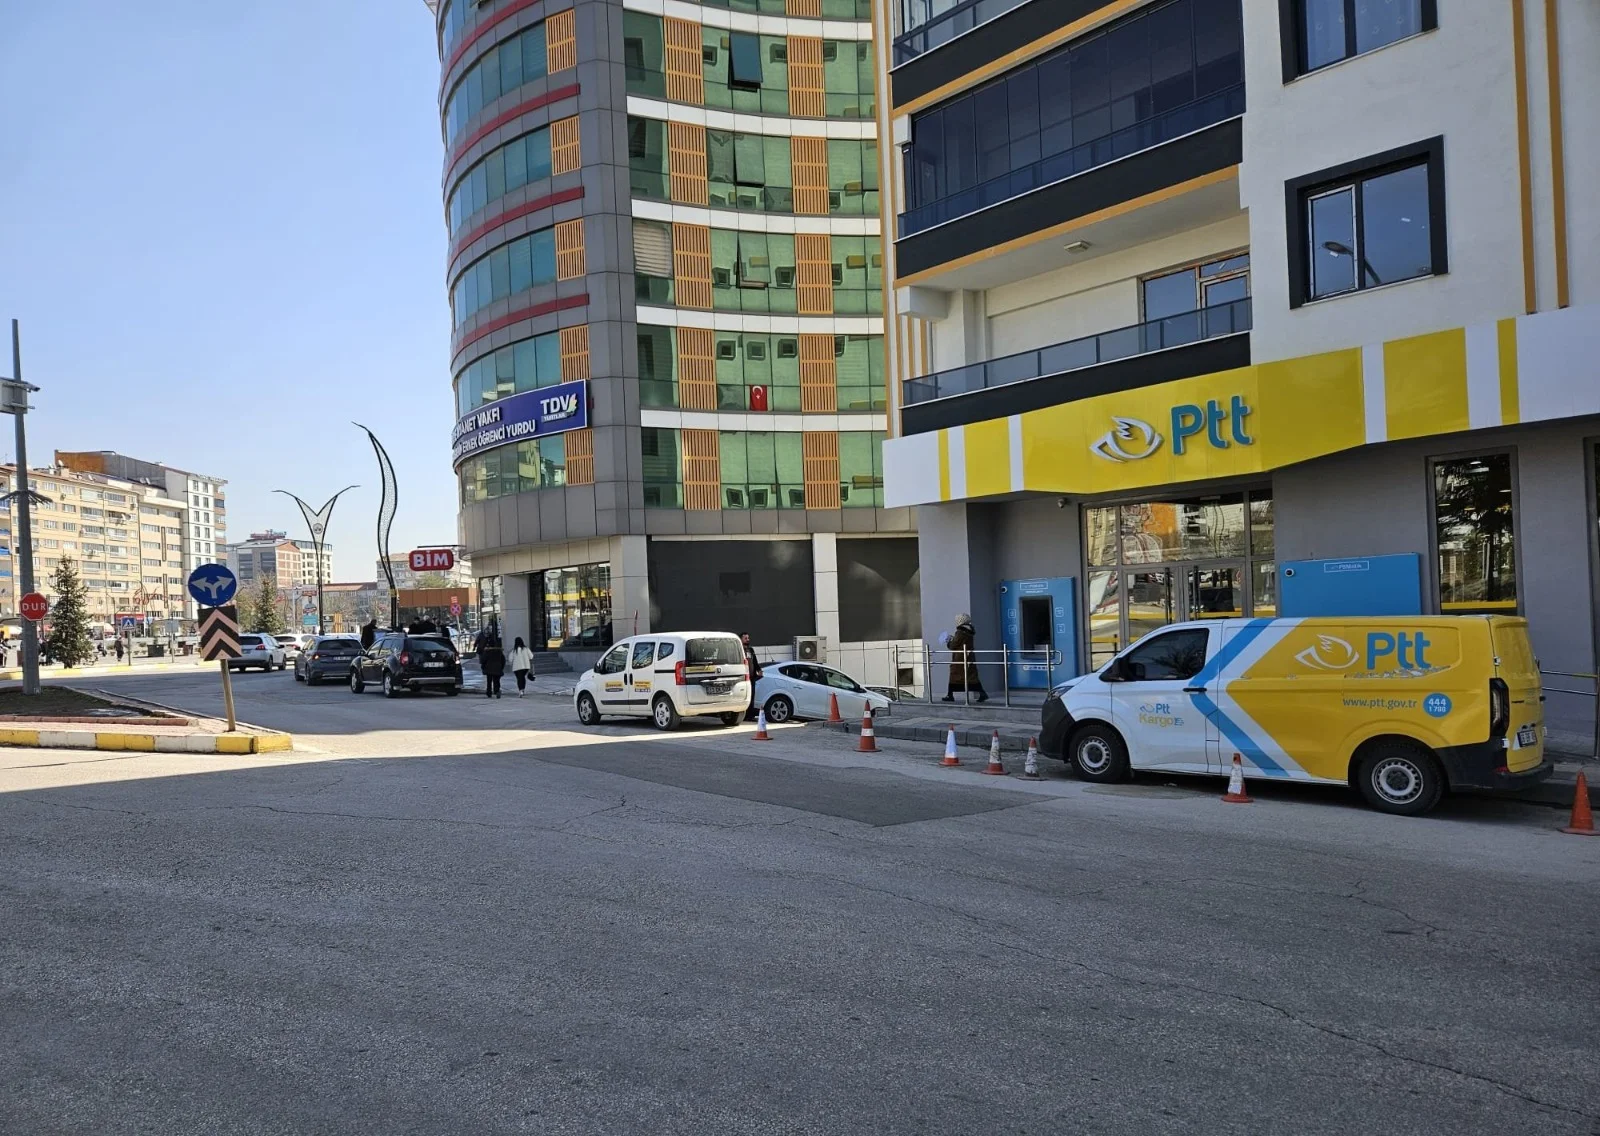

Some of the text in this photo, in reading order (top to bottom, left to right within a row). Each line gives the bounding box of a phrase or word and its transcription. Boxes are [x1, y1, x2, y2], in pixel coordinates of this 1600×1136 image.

[540, 394, 570, 415] TDV
[477, 407, 500, 428] VAKFI
[1171, 395, 1253, 455] Ptt
[462, 435, 478, 453] ERKEK
[478, 424, 506, 447] ÖĞRENCİ
[505, 419, 536, 438] YURDU
[413, 550, 449, 568] BİM
[22, 602, 46, 611] DUR
[1366, 631, 1431, 670] Ptt
[1155, 703, 1171, 715] Ptt
[1342, 697, 1418, 711] www.ptt.gov.tr
[1428, 698, 1447, 706] 444
[1139, 713, 1175, 728] Kargo
